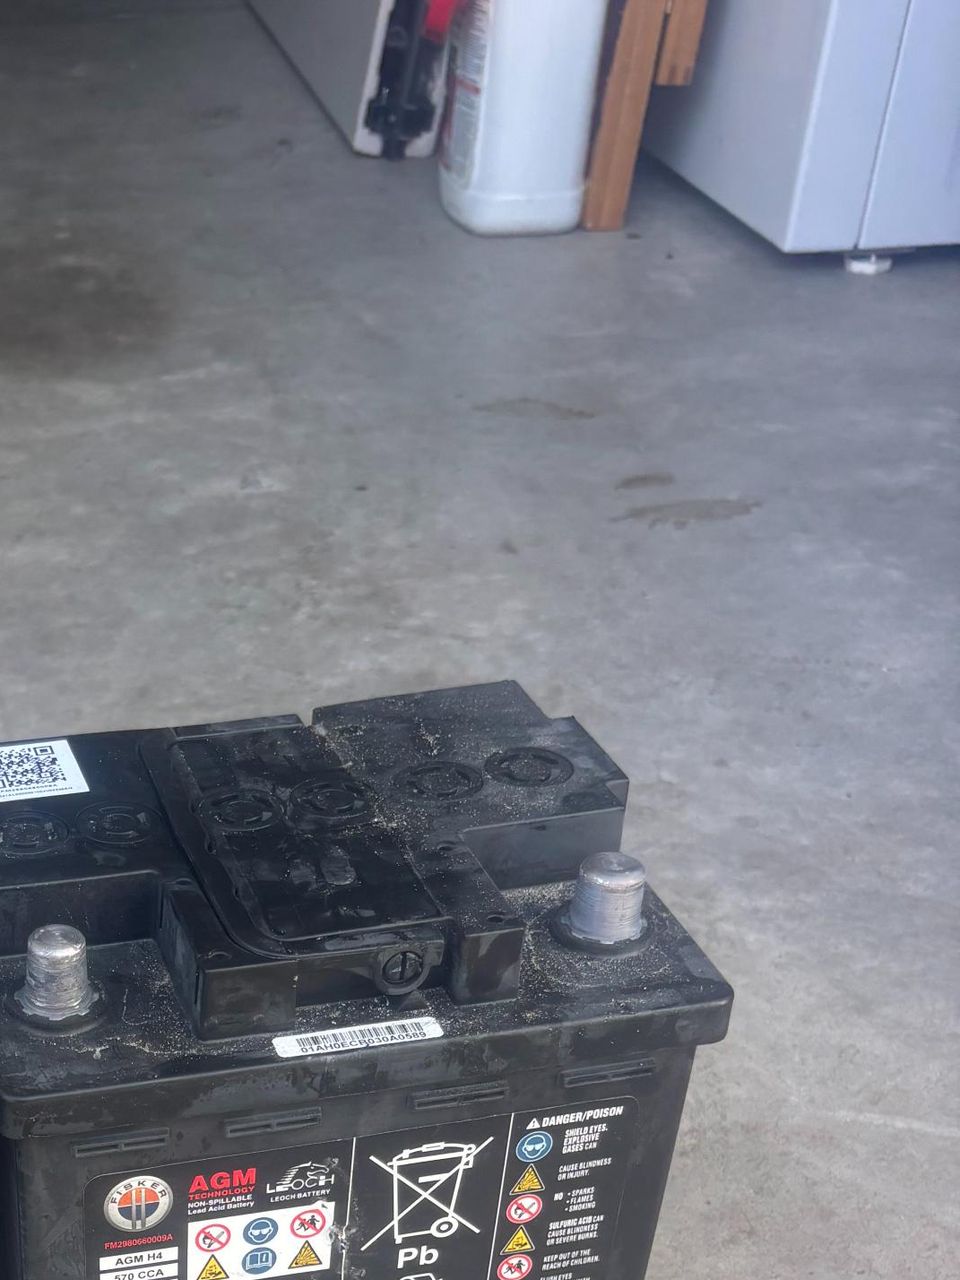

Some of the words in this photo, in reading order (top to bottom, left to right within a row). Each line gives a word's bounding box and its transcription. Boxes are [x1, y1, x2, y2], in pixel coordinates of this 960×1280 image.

[541, 1105, 624, 1128] DANGER/POISON
[563, 1132, 600, 1146] EXPLOSIVE
[565, 1127, 589, 1138] SHIELD
[562, 1143, 584, 1154] GASES
[584, 1141, 597, 1151] CAN
[188, 1167, 257, 1193] AGM
[110, 1180, 167, 1204] FISKER
[188, 1185, 255, 1201] TECHNOLOGY
[270, 1193, 296, 1203] LEOCH
[296, 1188, 331, 1199] BATTERY
[553, 1191, 564, 1201] NO
[187, 1193, 253, 1208] NON-SPILLABLE
[187, 1206, 206, 1216] Lead
[208, 1204, 225, 1213] Acid
[226, 1200, 255, 1210] Battery
[115, 1254, 144, 1266] AGM
[147, 1252, 163, 1261] H4
[397, 1245, 439, 1269] Pb
[137, 1268, 164, 1279] CCA
